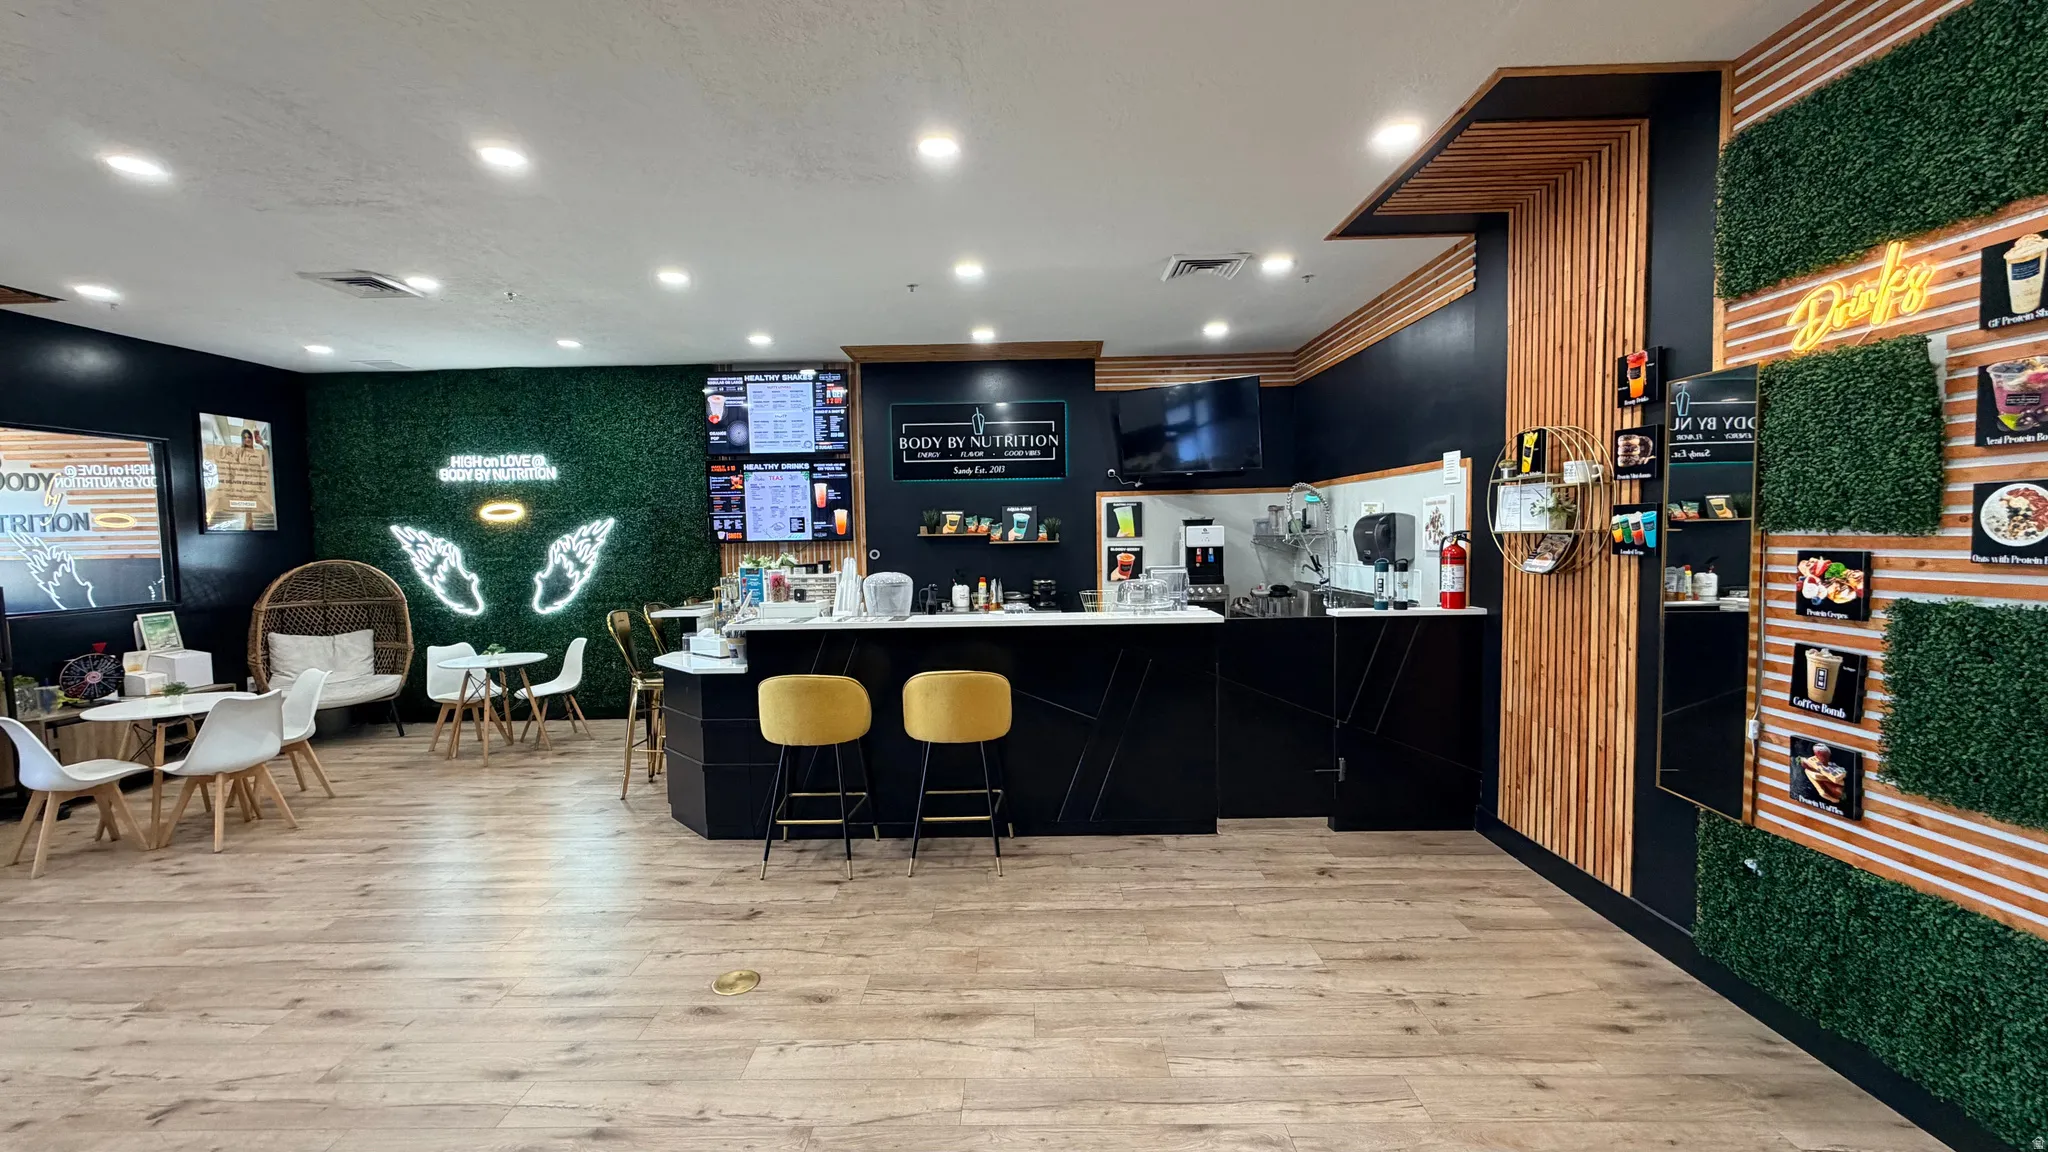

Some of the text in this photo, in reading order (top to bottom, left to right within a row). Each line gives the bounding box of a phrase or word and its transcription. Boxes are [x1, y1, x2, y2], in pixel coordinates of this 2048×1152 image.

[1787, 241, 1934, 352] Drinks
[2002, 312, 2034, 325] Protein
[900, 434, 1059, 450] BODY BY NUTRITION
[2004, 434, 2035, 444] Protein
[450, 454, 546, 468] HIGH on LOVE @
[439, 467, 558, 481] BODY BY NUTRITION
[953, 465, 1005, 476] Sandy Est. 2013
[44, 472, 63, 526] by
[1972, 554, 1990, 562] Oats
[1990, 555, 2009, 563] with
[2011, 555, 2043, 564] Protein
[1806, 608, 1826, 617] Protein
[1793, 696, 1846, 718] Coffee Bomb
[1819, 801, 1844, 816] Waffles
